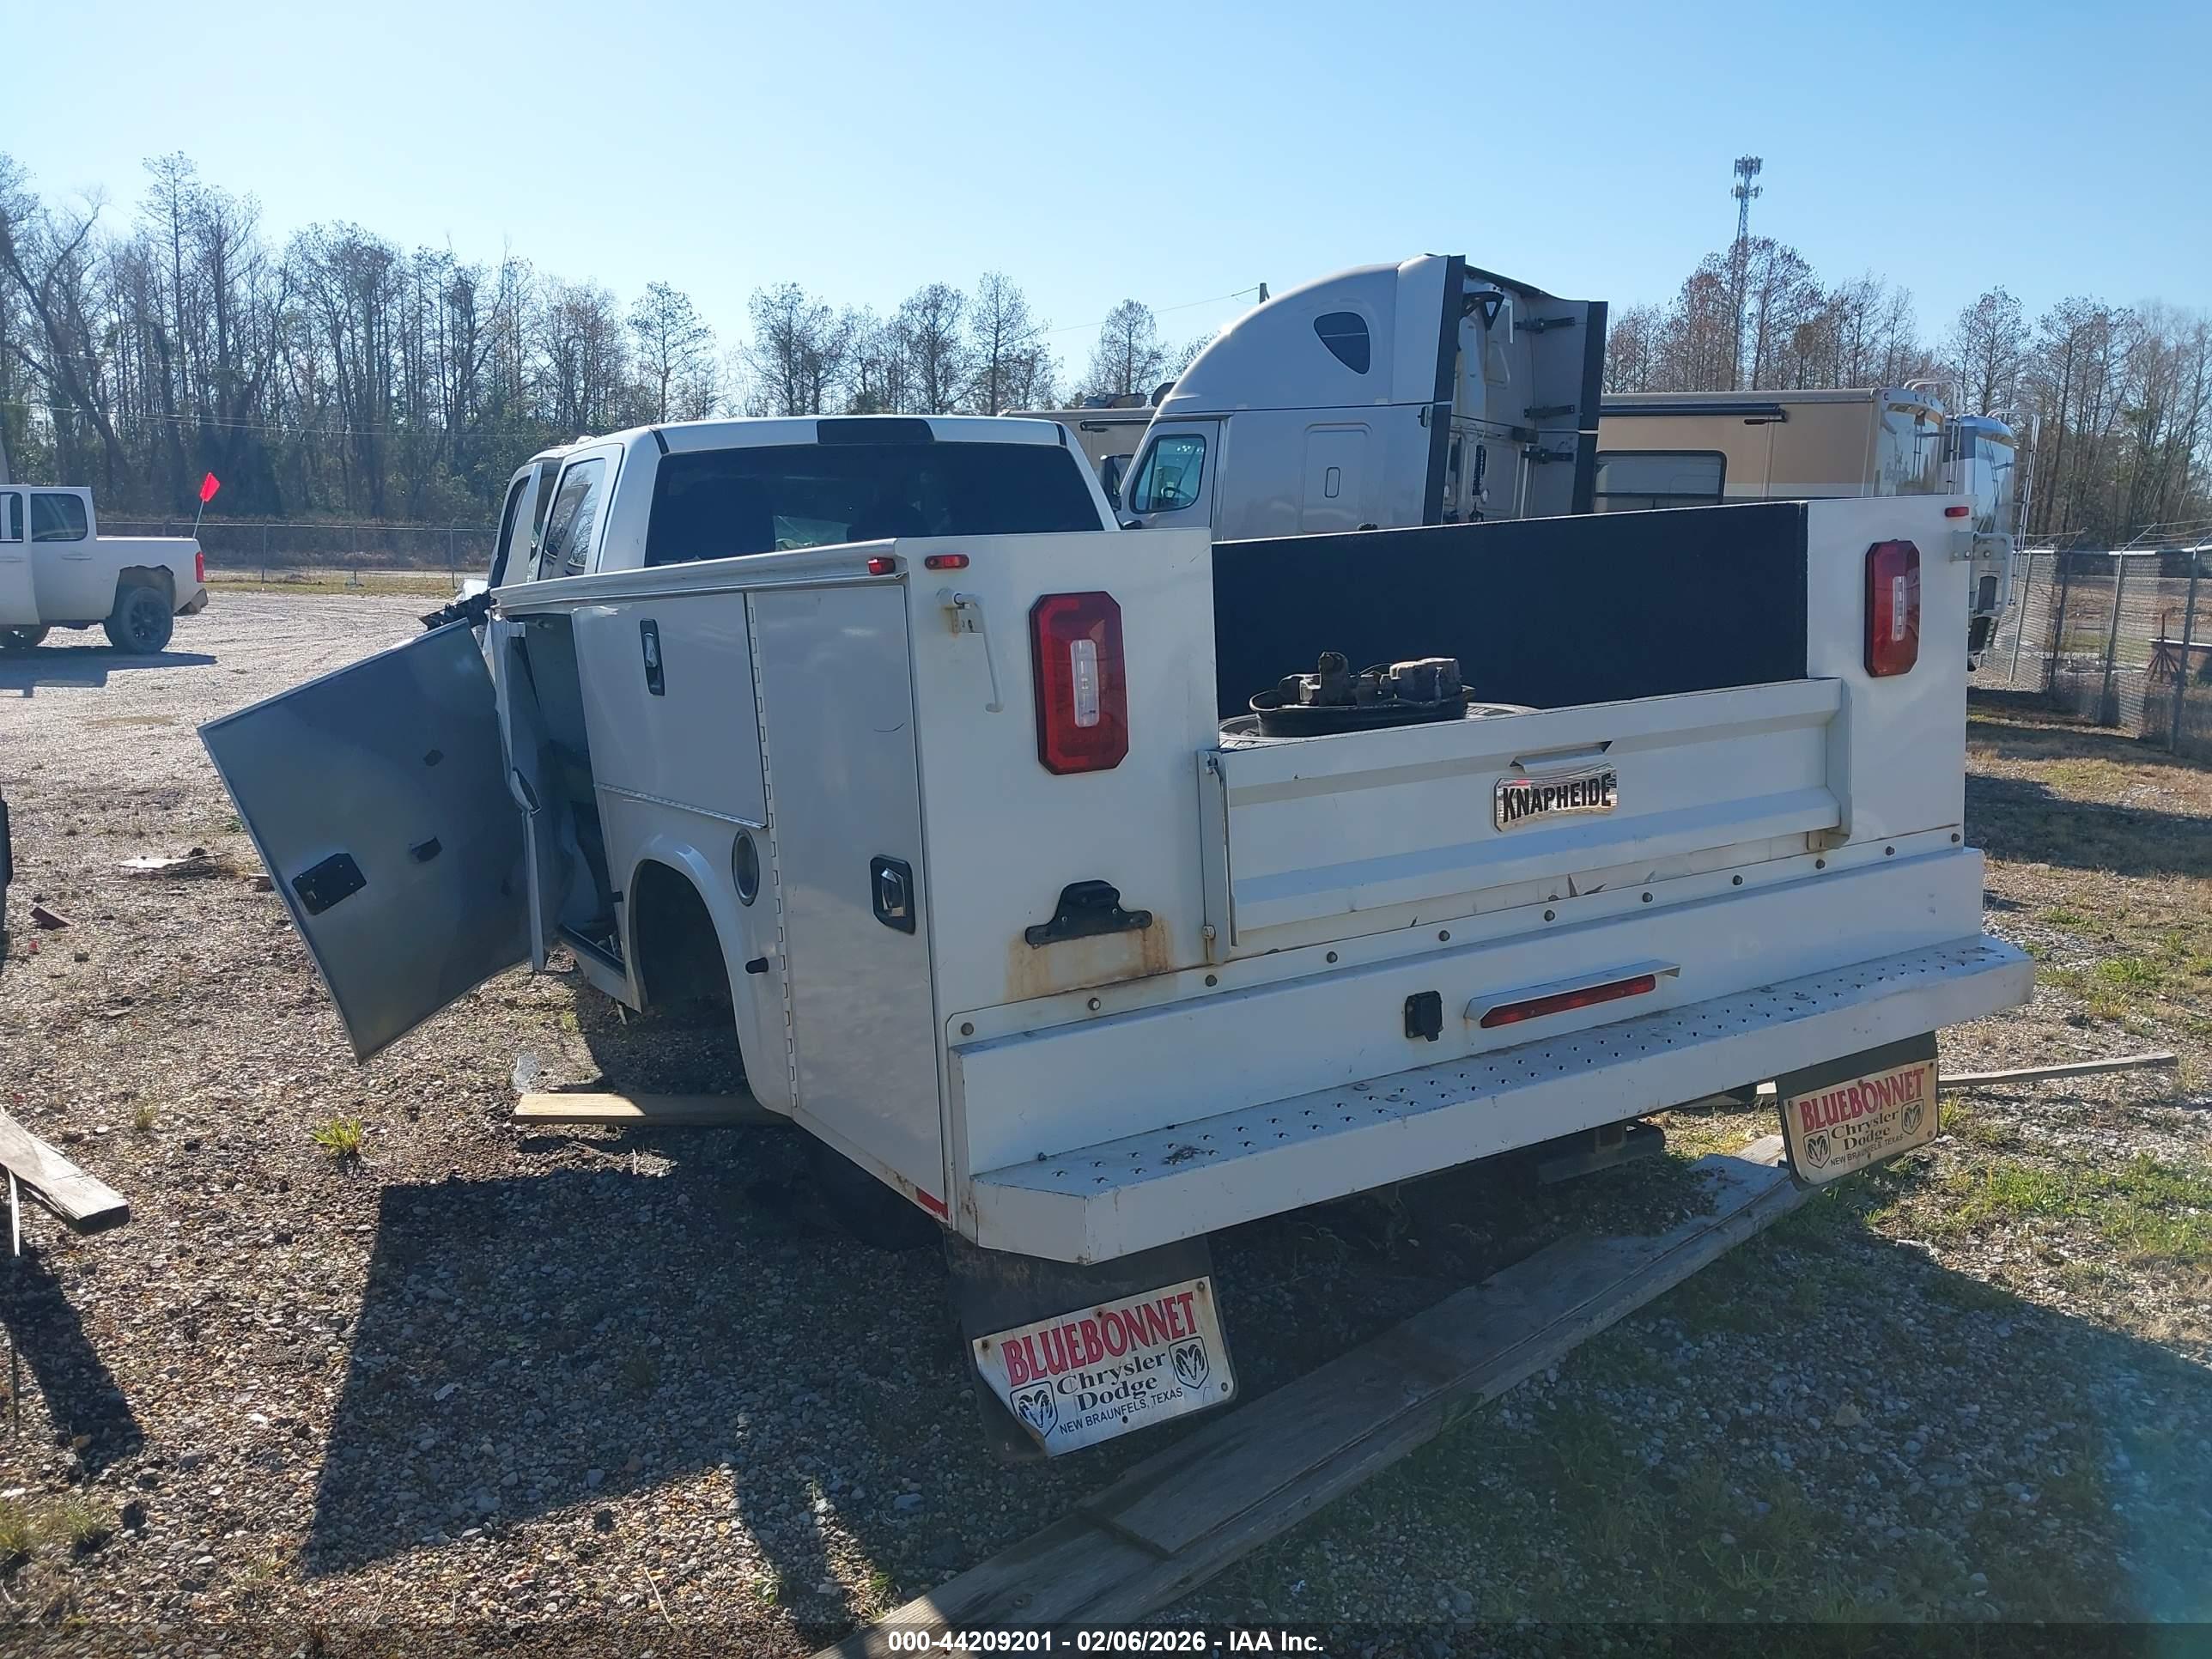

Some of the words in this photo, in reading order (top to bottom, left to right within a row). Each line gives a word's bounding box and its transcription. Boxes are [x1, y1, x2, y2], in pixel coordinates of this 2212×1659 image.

[1503, 773, 1612, 823] KNAPHEIDE
[1800, 1067, 1925, 1133] BLUEBONNET
[1831, 1110, 1899, 1139] Chrysler
[1843, 1127, 1890, 1151] Dodge
[1830, 1153, 1846, 1167] NEW
[1884, 1133, 1904, 1146] TEXAS
[1001, 1291, 1197, 1388] BLUEBONNET
[1057, 1351, 1167, 1396] Chrysler
[1077, 1376, 1158, 1413] Dodge
[1059, 1419, 1084, 1435] NEW
[1085, 1398, 1150, 1427] BRAUNFELS,
[1151, 1387, 1183, 1406] TEXAS
